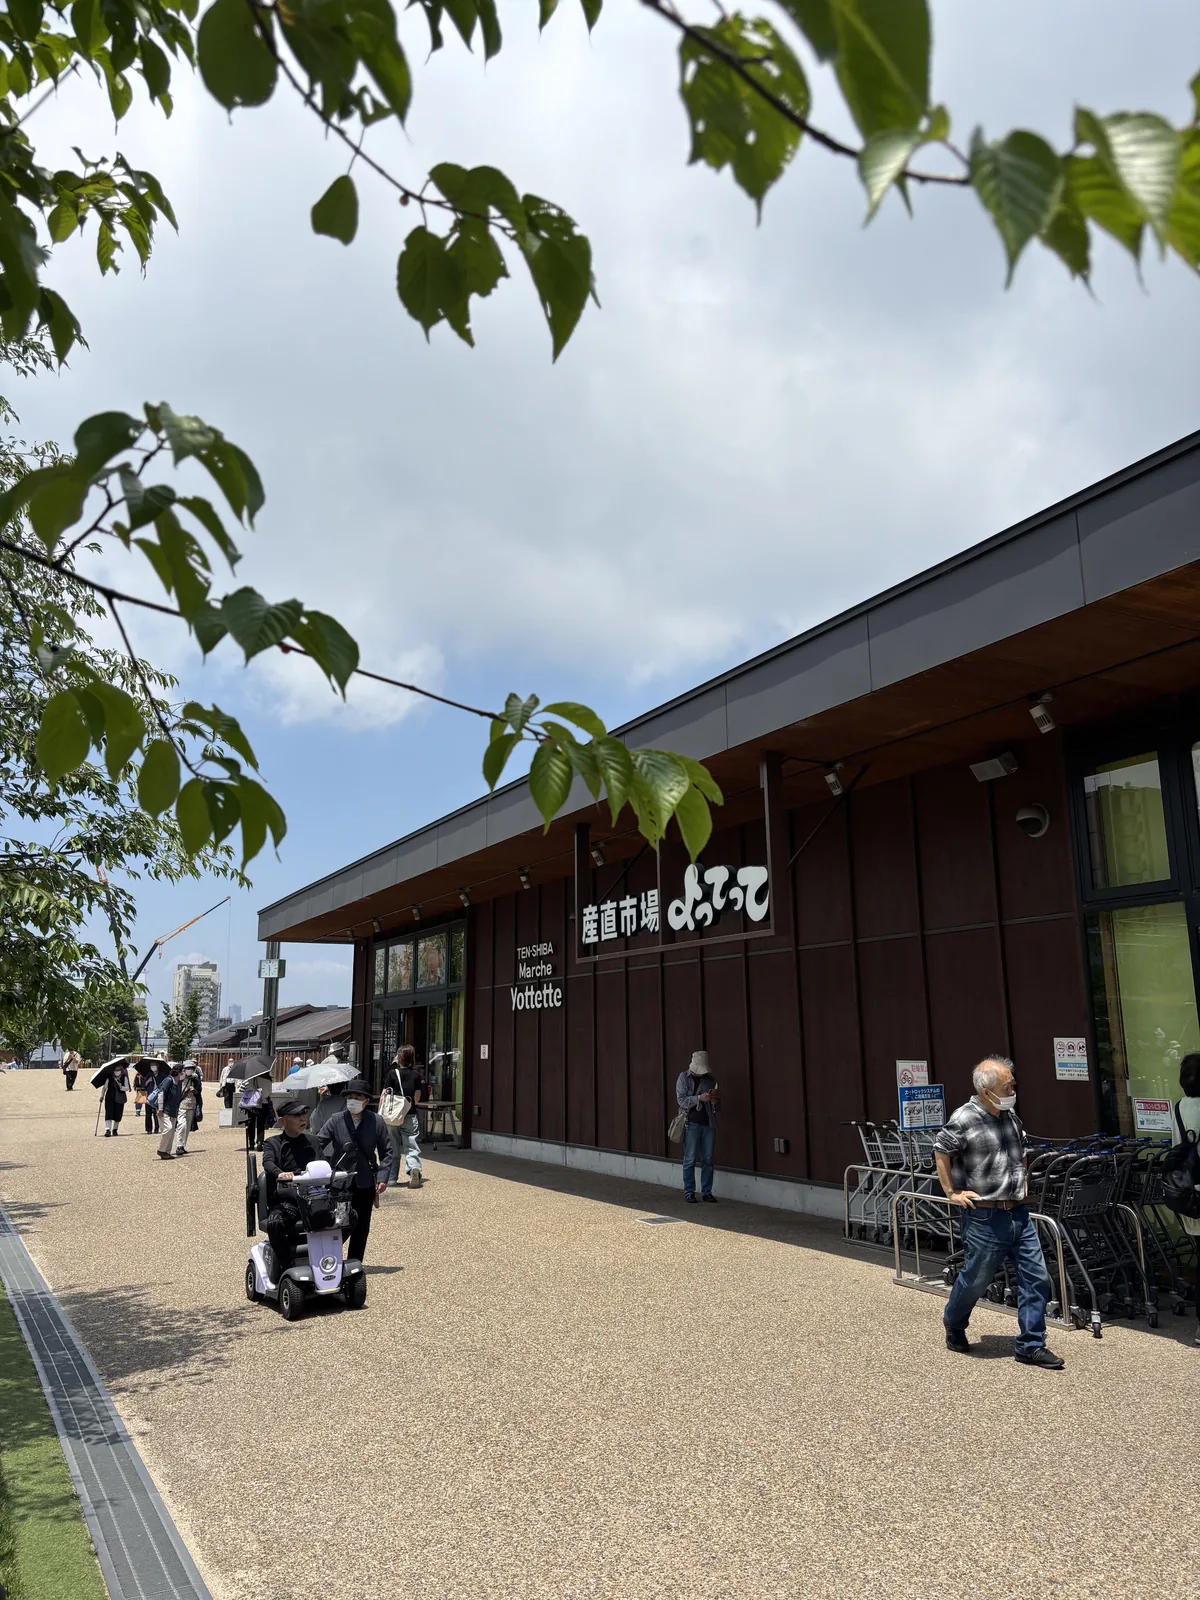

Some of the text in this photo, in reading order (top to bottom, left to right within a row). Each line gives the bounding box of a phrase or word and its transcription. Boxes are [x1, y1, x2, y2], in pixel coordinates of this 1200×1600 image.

[582, 863, 770, 946] 産直市場 よってって
[519, 960, 552, 979] Marche
[510, 982, 562, 1011] Yottette
